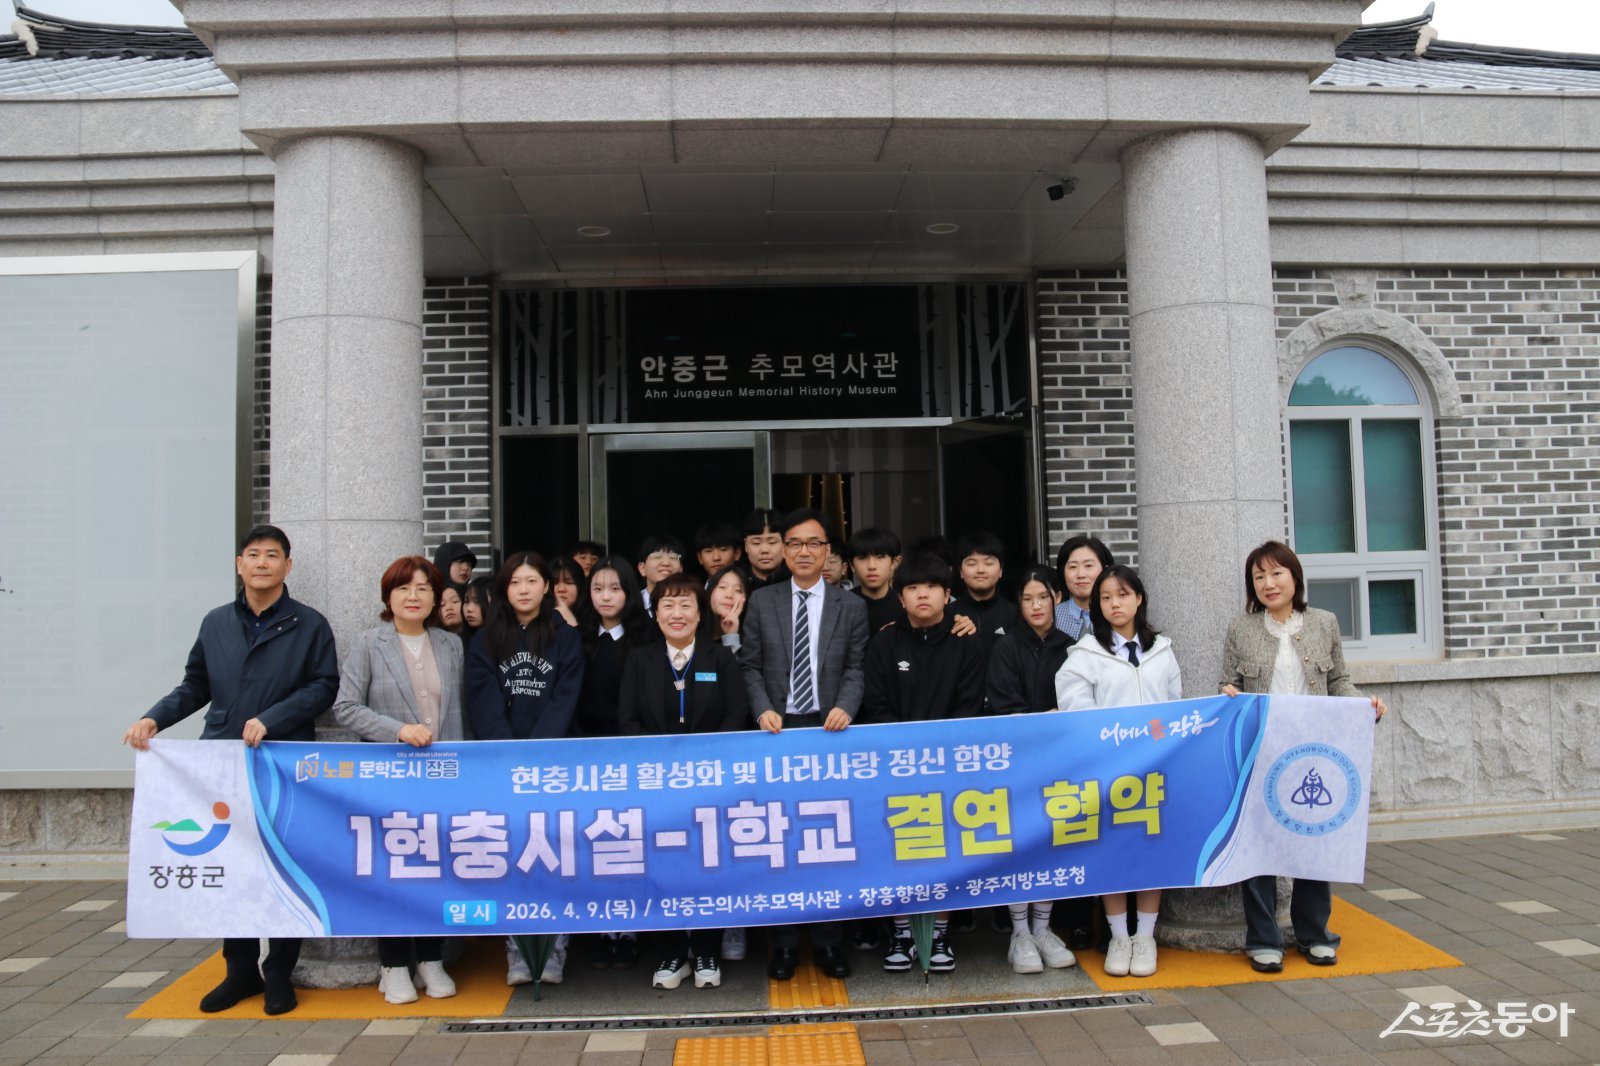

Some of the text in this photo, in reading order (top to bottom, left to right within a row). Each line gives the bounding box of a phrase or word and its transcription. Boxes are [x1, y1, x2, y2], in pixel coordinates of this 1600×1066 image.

[640, 352, 899, 383] 안중근 추모역사관
[644, 385, 898, 399] Ahn Junggeun Memorial History Museum
[505, 677, 546, 689] AUTHENTIC
[1168, 710, 1220, 738] 장흥
[323, 759, 459, 779] 노벨 문학도시 장흥
[511, 743, 1013, 794] 현충시설 활성화 및 나라사랑 정신 함양
[1332, 751, 1354, 775] MIDDLE
[1348, 777, 1358, 808] SCHOOL
[349, 771, 1166, 880] 1현충시설-1학교 결연 협약
[149, 864, 226, 890] 장흥군
[505, 902, 557, 920] 2026.
[563, 903, 581, 920] 4.
[586, 899, 637, 919] 9.(목)
[660, 889, 841, 917] 안중근의사추모역사관
[859, 881, 947, 908] 장흥향원중
[966, 865, 1086, 896] 광주지방보훈청
